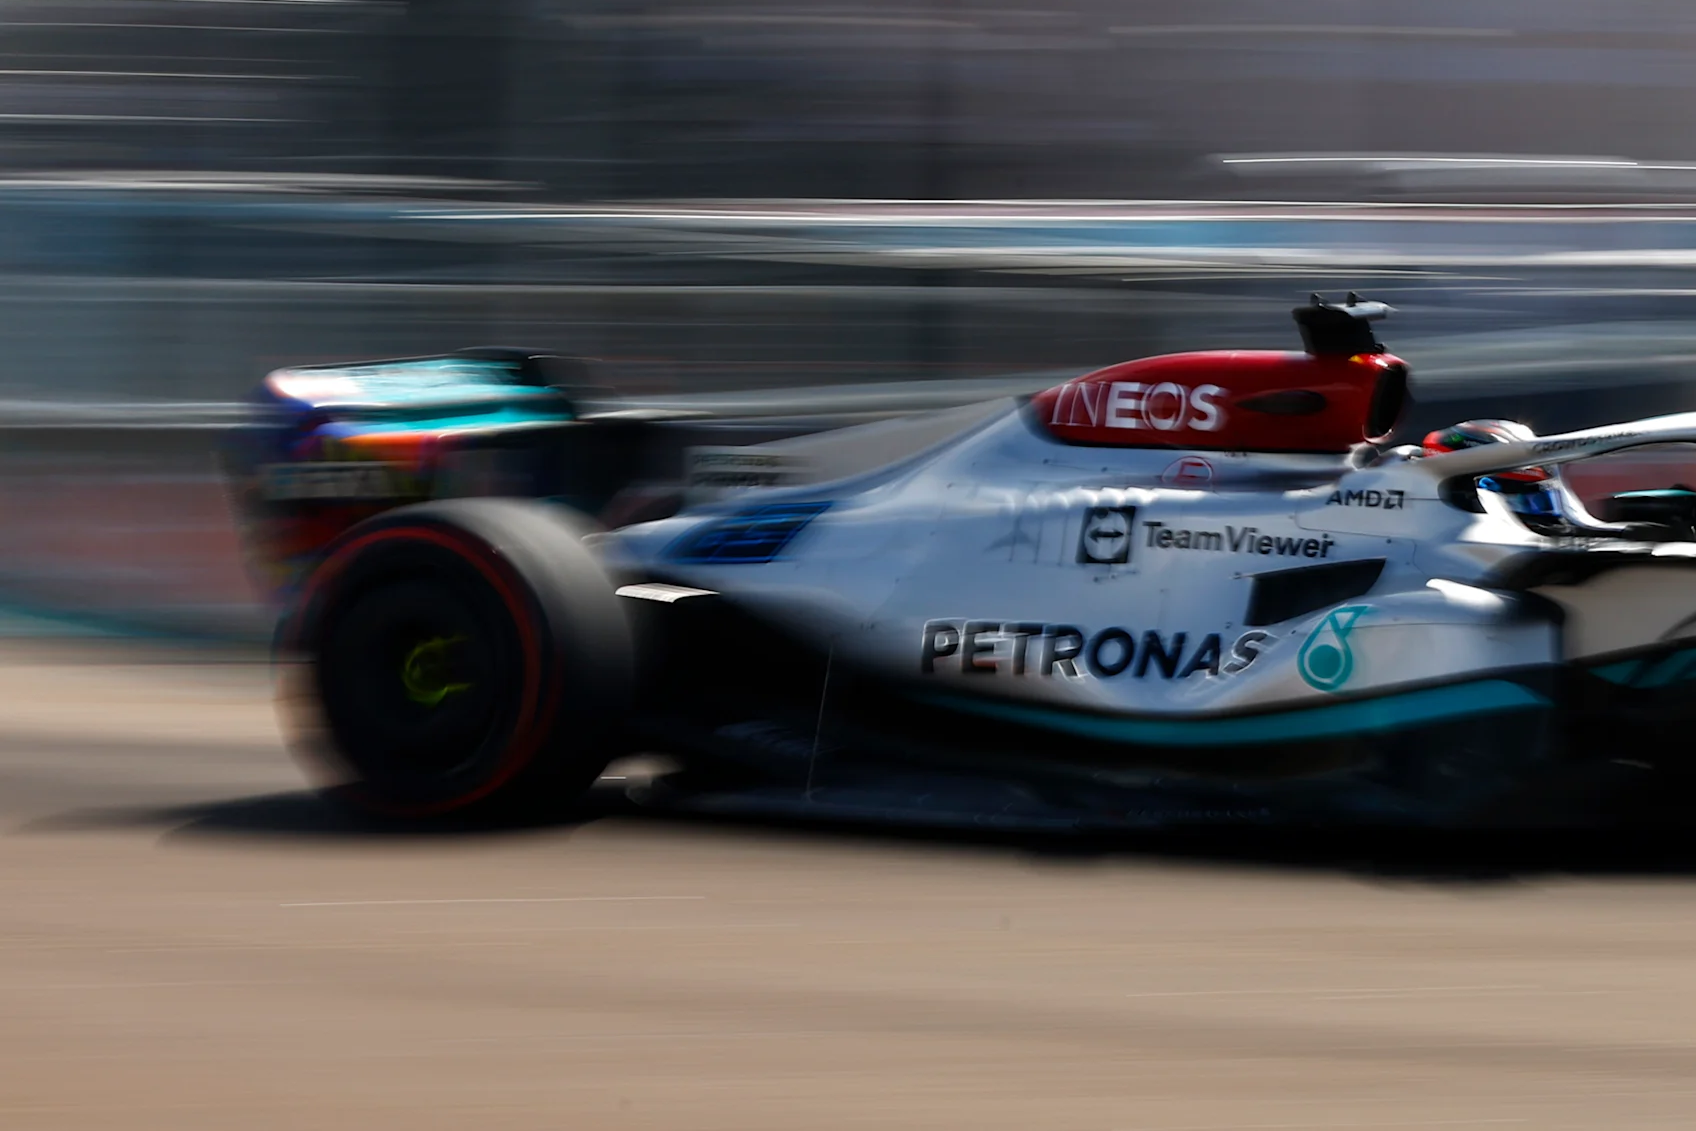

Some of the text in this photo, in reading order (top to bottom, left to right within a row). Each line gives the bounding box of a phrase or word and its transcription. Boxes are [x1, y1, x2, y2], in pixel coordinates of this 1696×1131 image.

[1049, 381, 1226, 431] INEOS
[1325, 489, 1382, 508] AMD
[1143, 521, 1335, 558] TeamViewer
[920, 618, 1272, 679] PETRONAS
